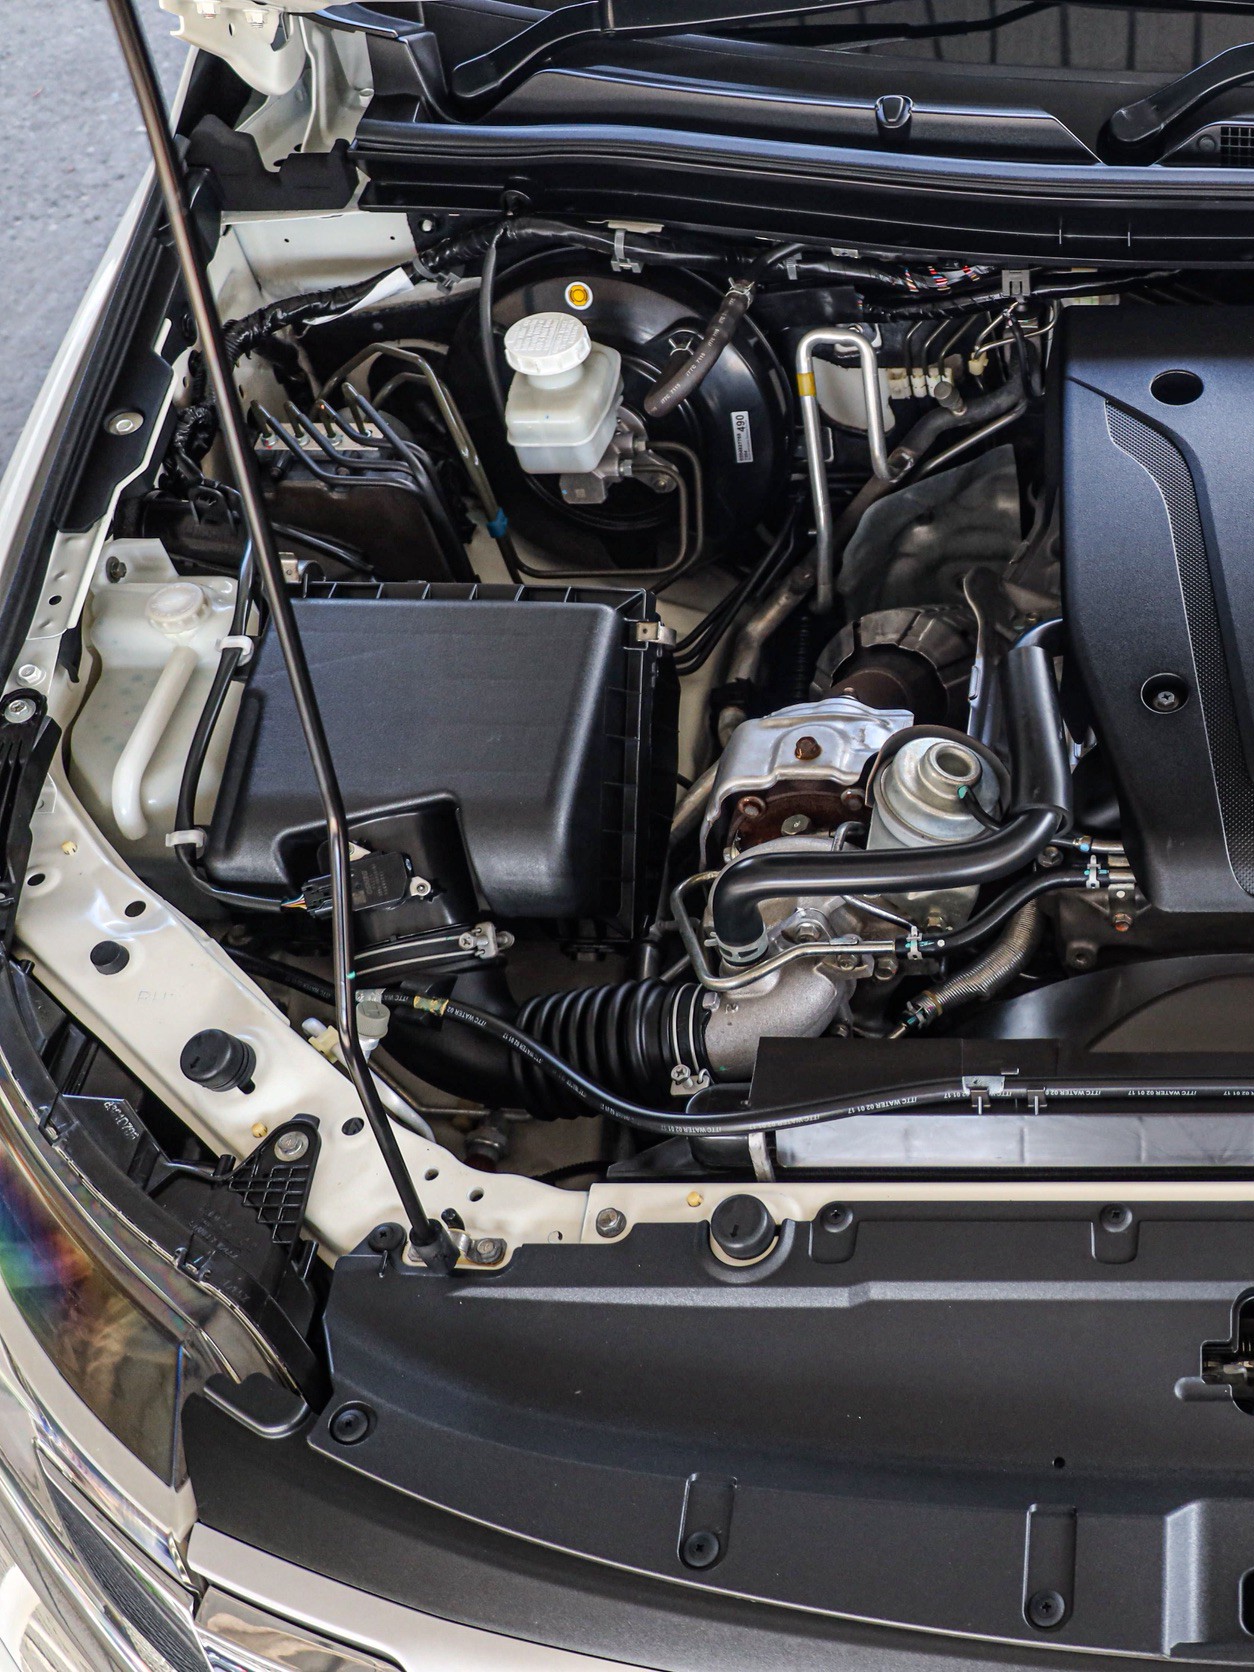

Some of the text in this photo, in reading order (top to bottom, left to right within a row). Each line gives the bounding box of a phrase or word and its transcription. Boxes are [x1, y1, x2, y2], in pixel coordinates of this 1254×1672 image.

[735, 414, 746, 432] 490
[454, 1008, 475, 1022] WATER
[865, 1103, 874, 1111] 02
[875, 1099, 901, 1109] WATER
